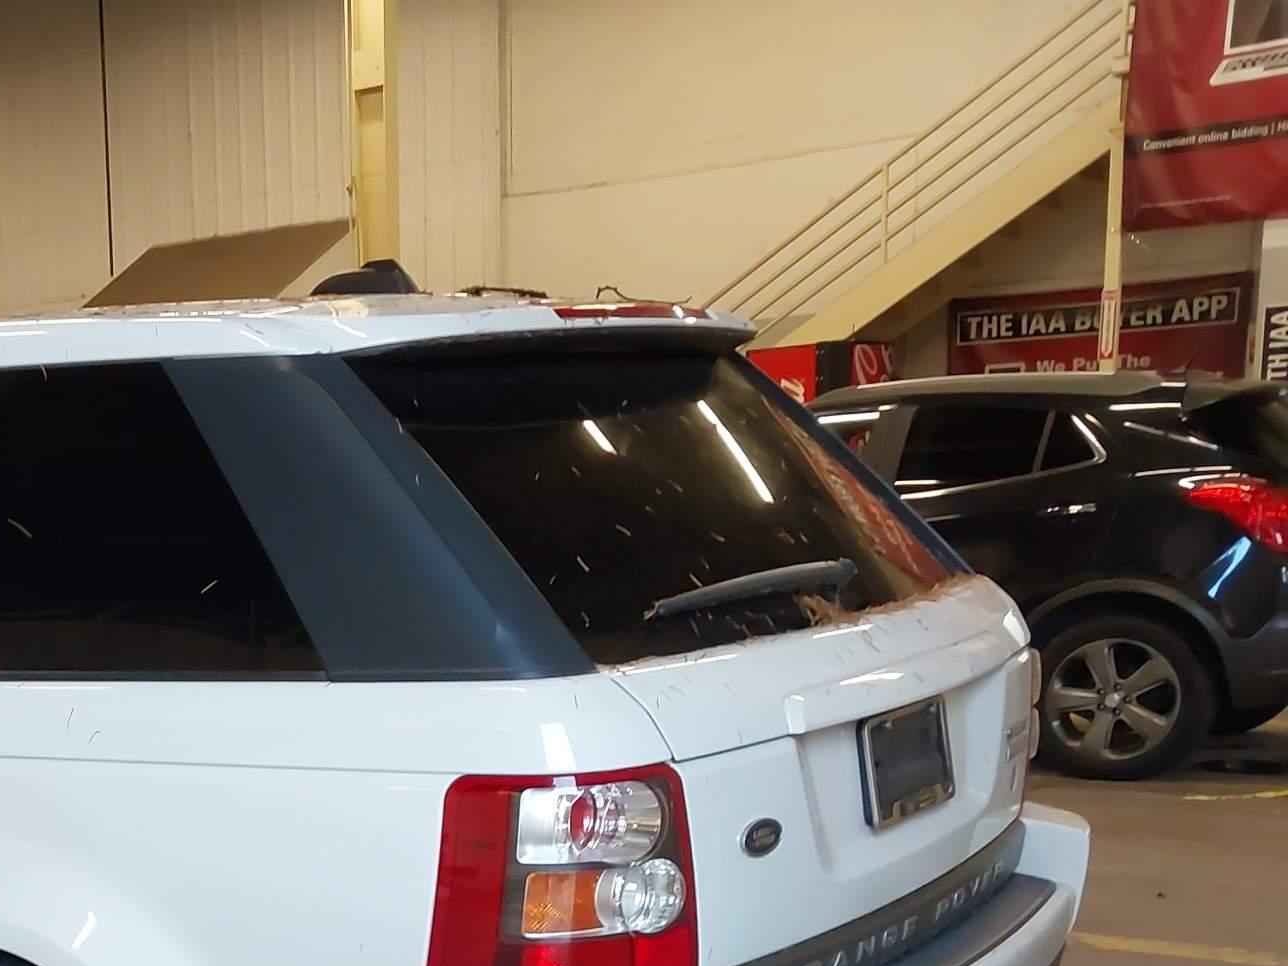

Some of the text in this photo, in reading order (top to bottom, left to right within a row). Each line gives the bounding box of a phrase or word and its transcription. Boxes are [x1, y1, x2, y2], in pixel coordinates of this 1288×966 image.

[1142, 134, 1196, 151] Convenient
[1198, 130, 1230, 145] online
[1231, 123, 1269, 140] bidding
[967, 294, 1228, 339] THE IAA BER APP
[1072, 356, 1100, 372] Pu
[1119, 353, 1152, 369] The
